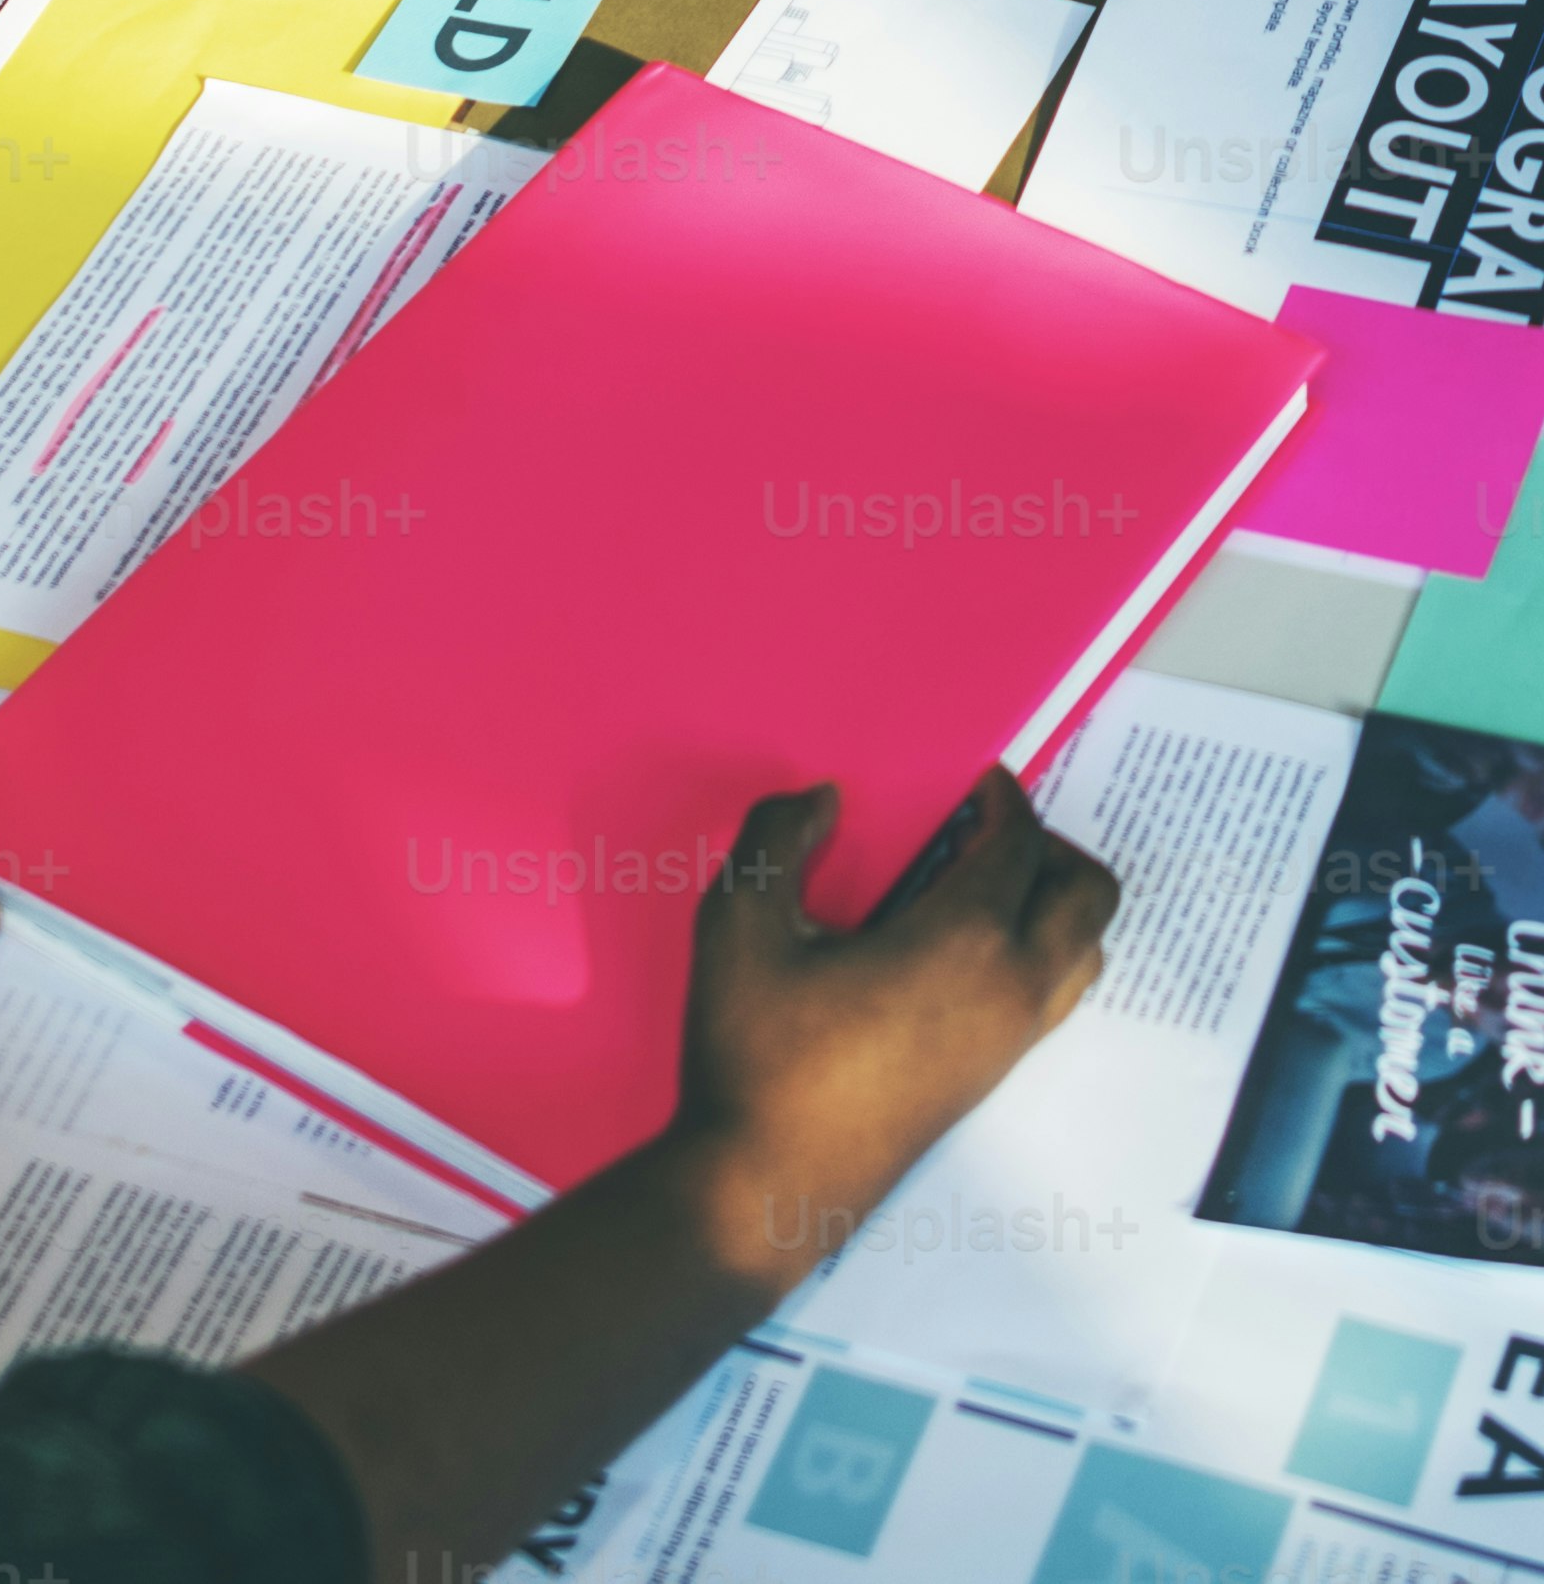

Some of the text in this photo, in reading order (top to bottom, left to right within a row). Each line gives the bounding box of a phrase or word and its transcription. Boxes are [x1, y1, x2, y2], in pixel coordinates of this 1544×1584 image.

[1310, 0, 1337, 34] layout
[1290, 77, 1325, 135] magazine
[1372, 877, 1451, 1143] customer
[1445, 943, 1496, 1061] like a
